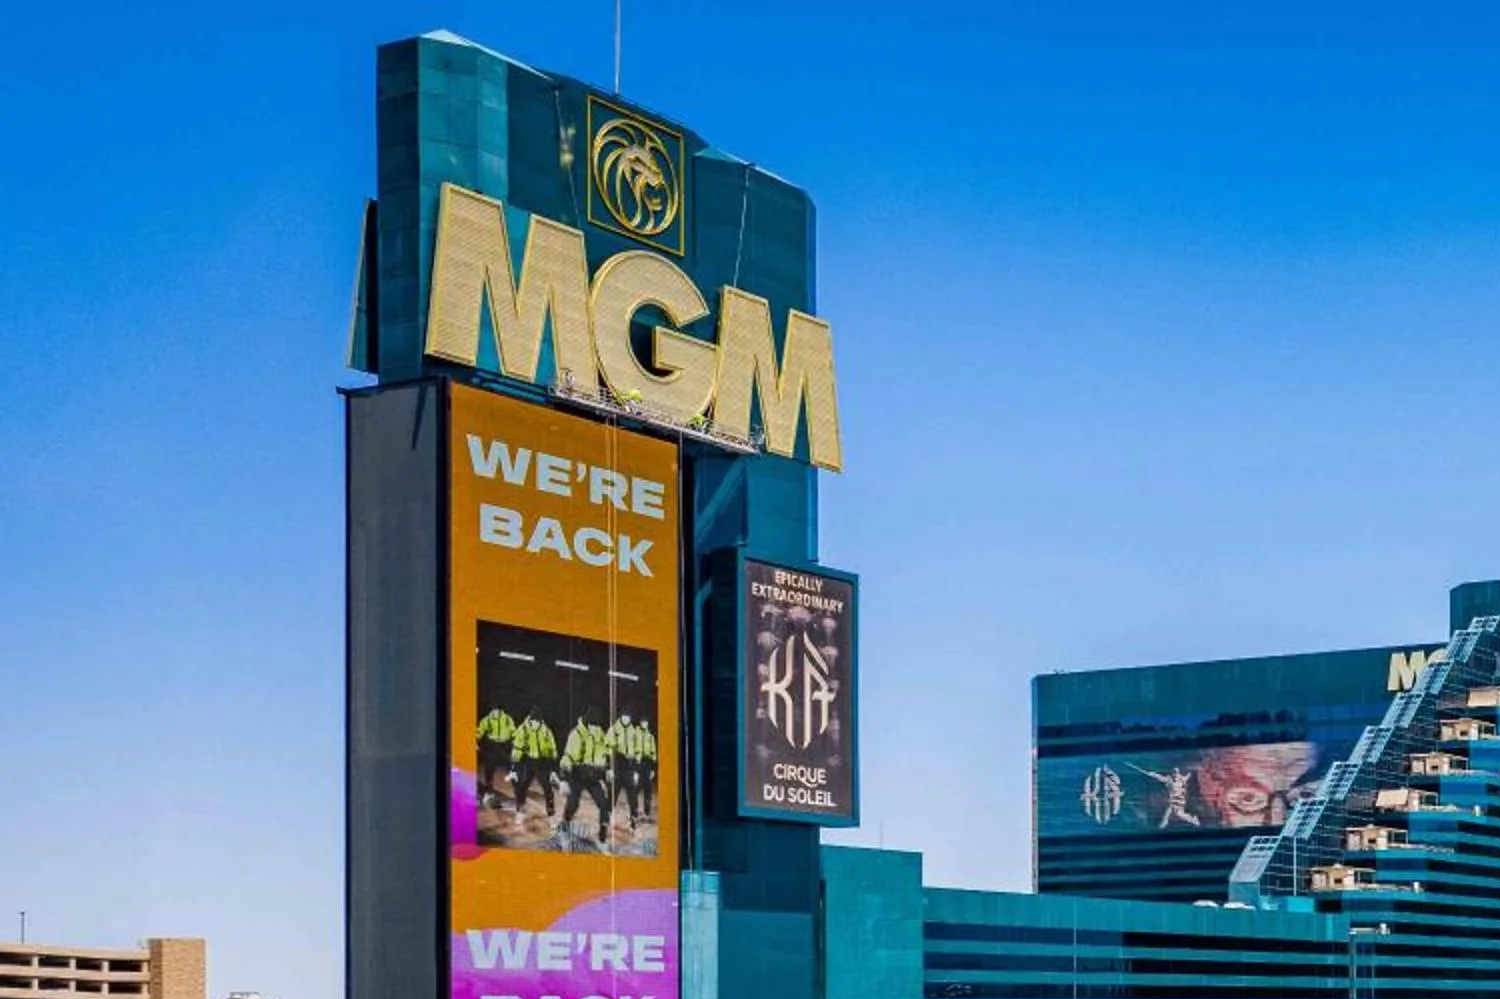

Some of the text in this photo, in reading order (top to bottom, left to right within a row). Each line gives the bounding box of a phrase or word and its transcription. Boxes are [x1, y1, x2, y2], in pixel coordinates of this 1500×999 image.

[424, 181, 843, 473] MGM
[466, 433, 665, 520] WE'RE
[479, 504, 653, 577] BACK
[751, 582, 844, 613] EXTRAORDINARY
[774, 570, 823, 592] EPICALLY
[773, 763, 828, 788] CIRQUE
[763, 784, 837, 807] DU SOLEIL
[466, 929, 665, 972] WE'RE
